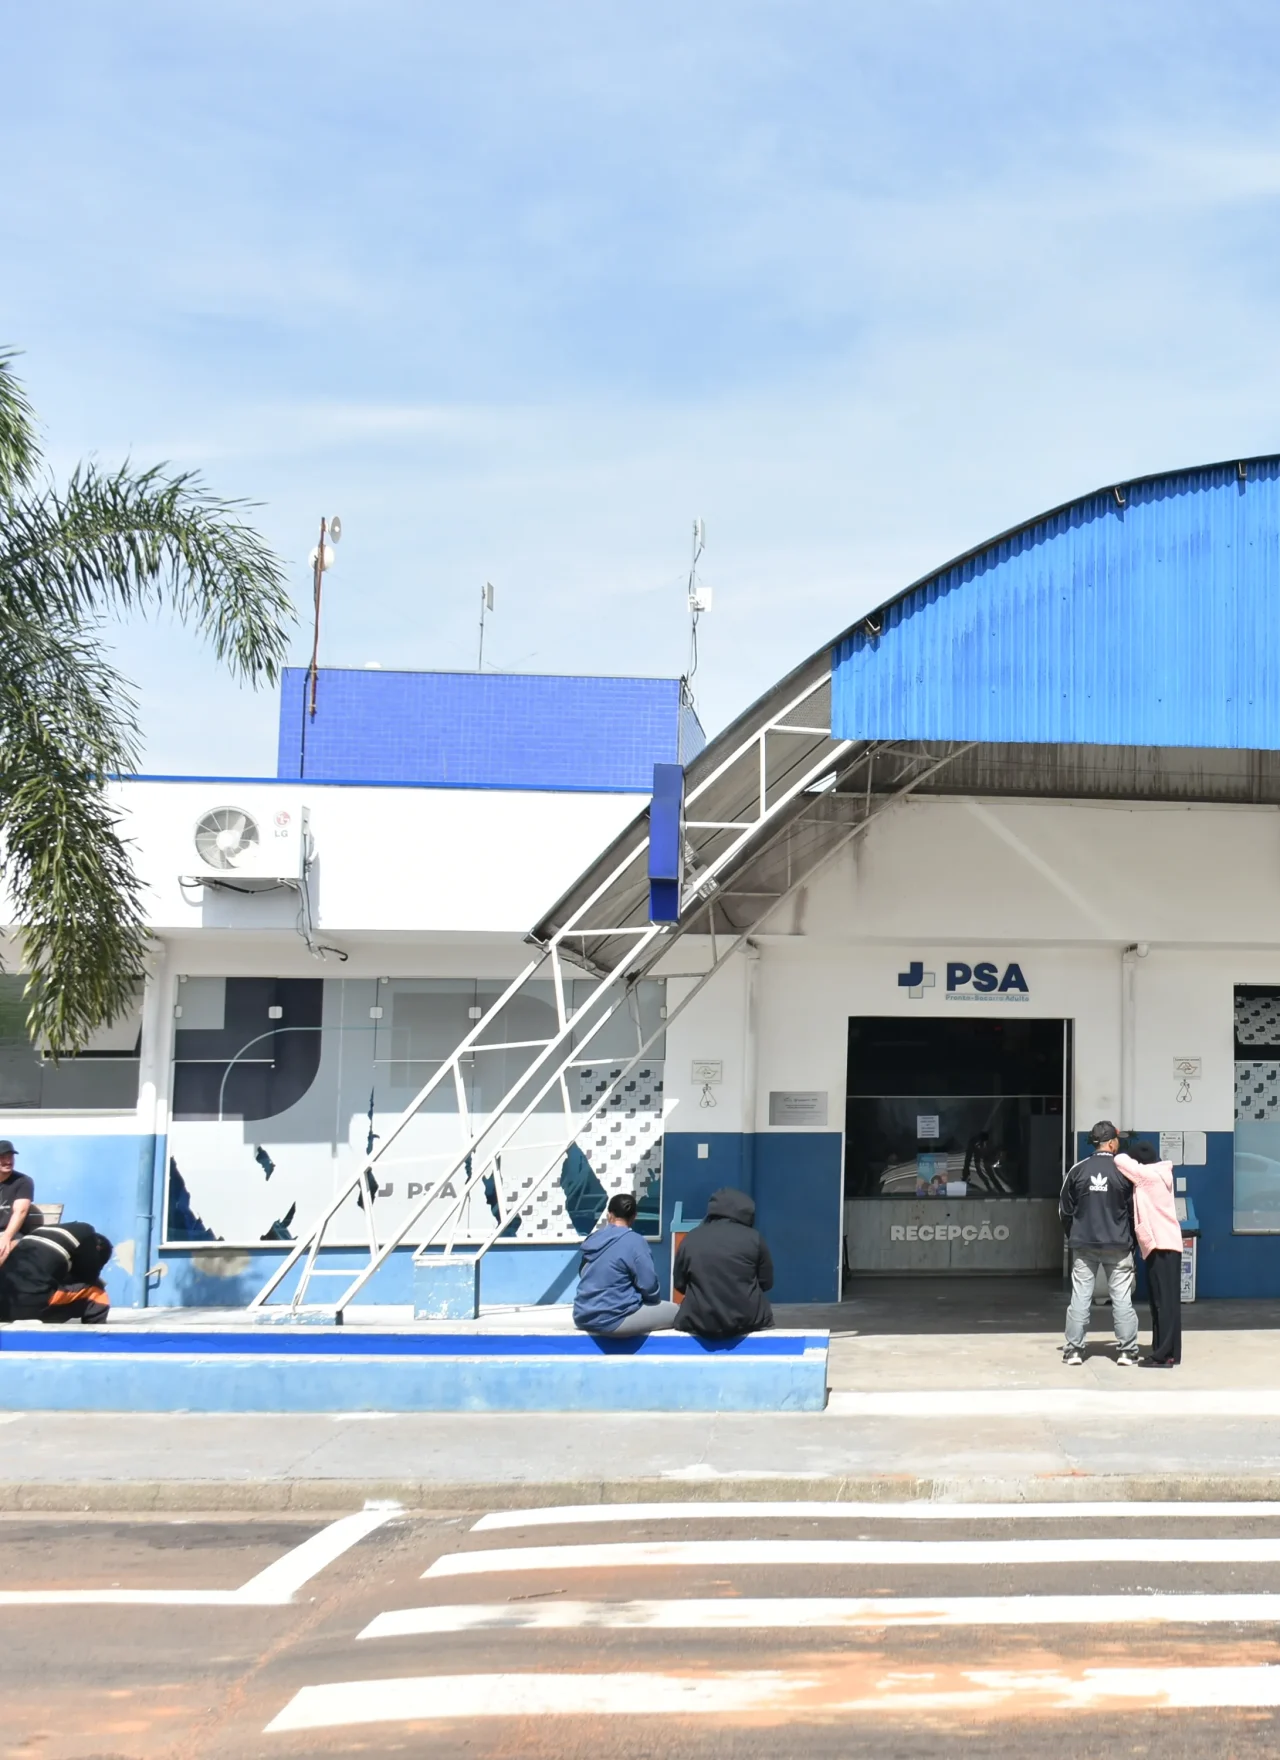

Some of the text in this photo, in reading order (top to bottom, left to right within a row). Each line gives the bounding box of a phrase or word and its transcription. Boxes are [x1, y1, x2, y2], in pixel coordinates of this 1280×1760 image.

[274, 829, 289, 838] LG
[946, 962, 1029, 992] PSA
[890, 1220, 1010, 1246] RECEPÇÃO
